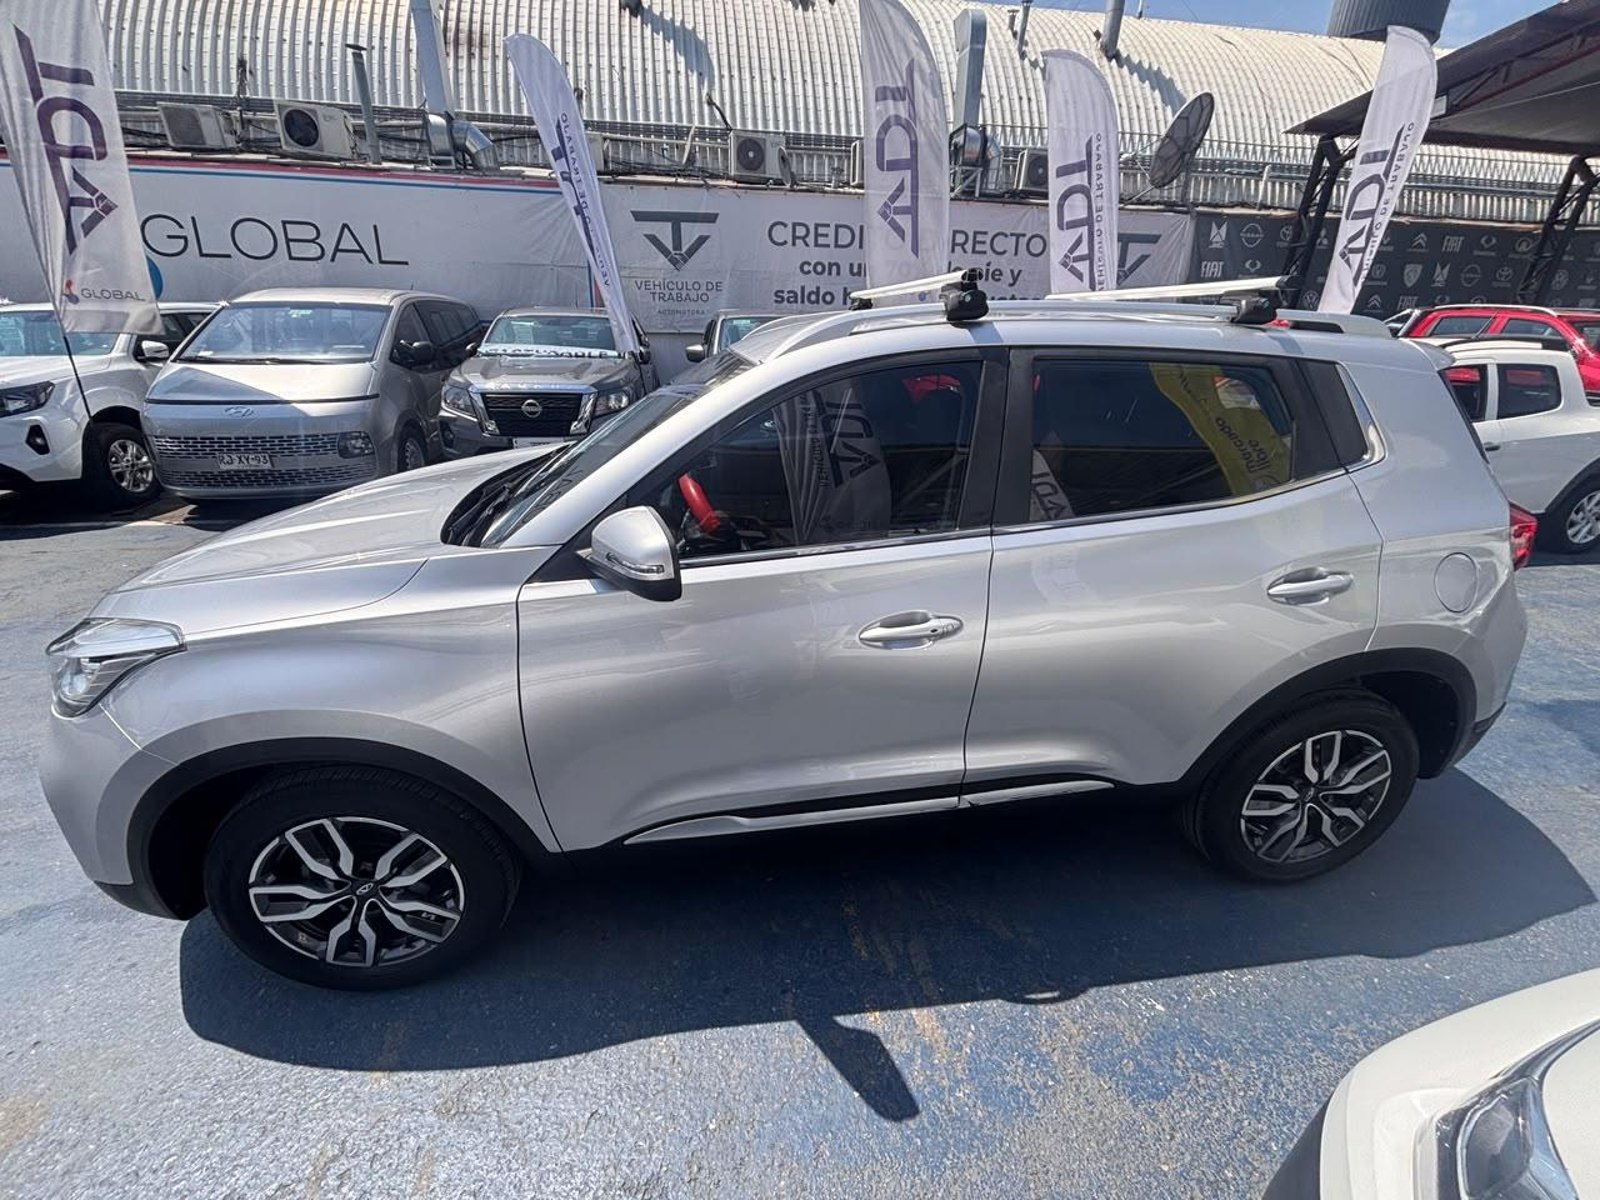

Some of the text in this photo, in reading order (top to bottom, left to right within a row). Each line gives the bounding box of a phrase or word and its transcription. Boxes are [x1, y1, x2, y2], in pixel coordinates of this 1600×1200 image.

[140, 214, 409, 266] GLOBAL
[767, 221, 1047, 257] CREDI RECTO
[800, 261, 841, 276] con
[1008, 269, 1022, 287] y
[1201, 260, 1225, 278] FIAT
[80, 288, 146, 302] GLOBAL
[706, 281, 723, 291] DE
[774, 285, 835, 305] saldo
[650, 292, 709, 303] TRABAJO
